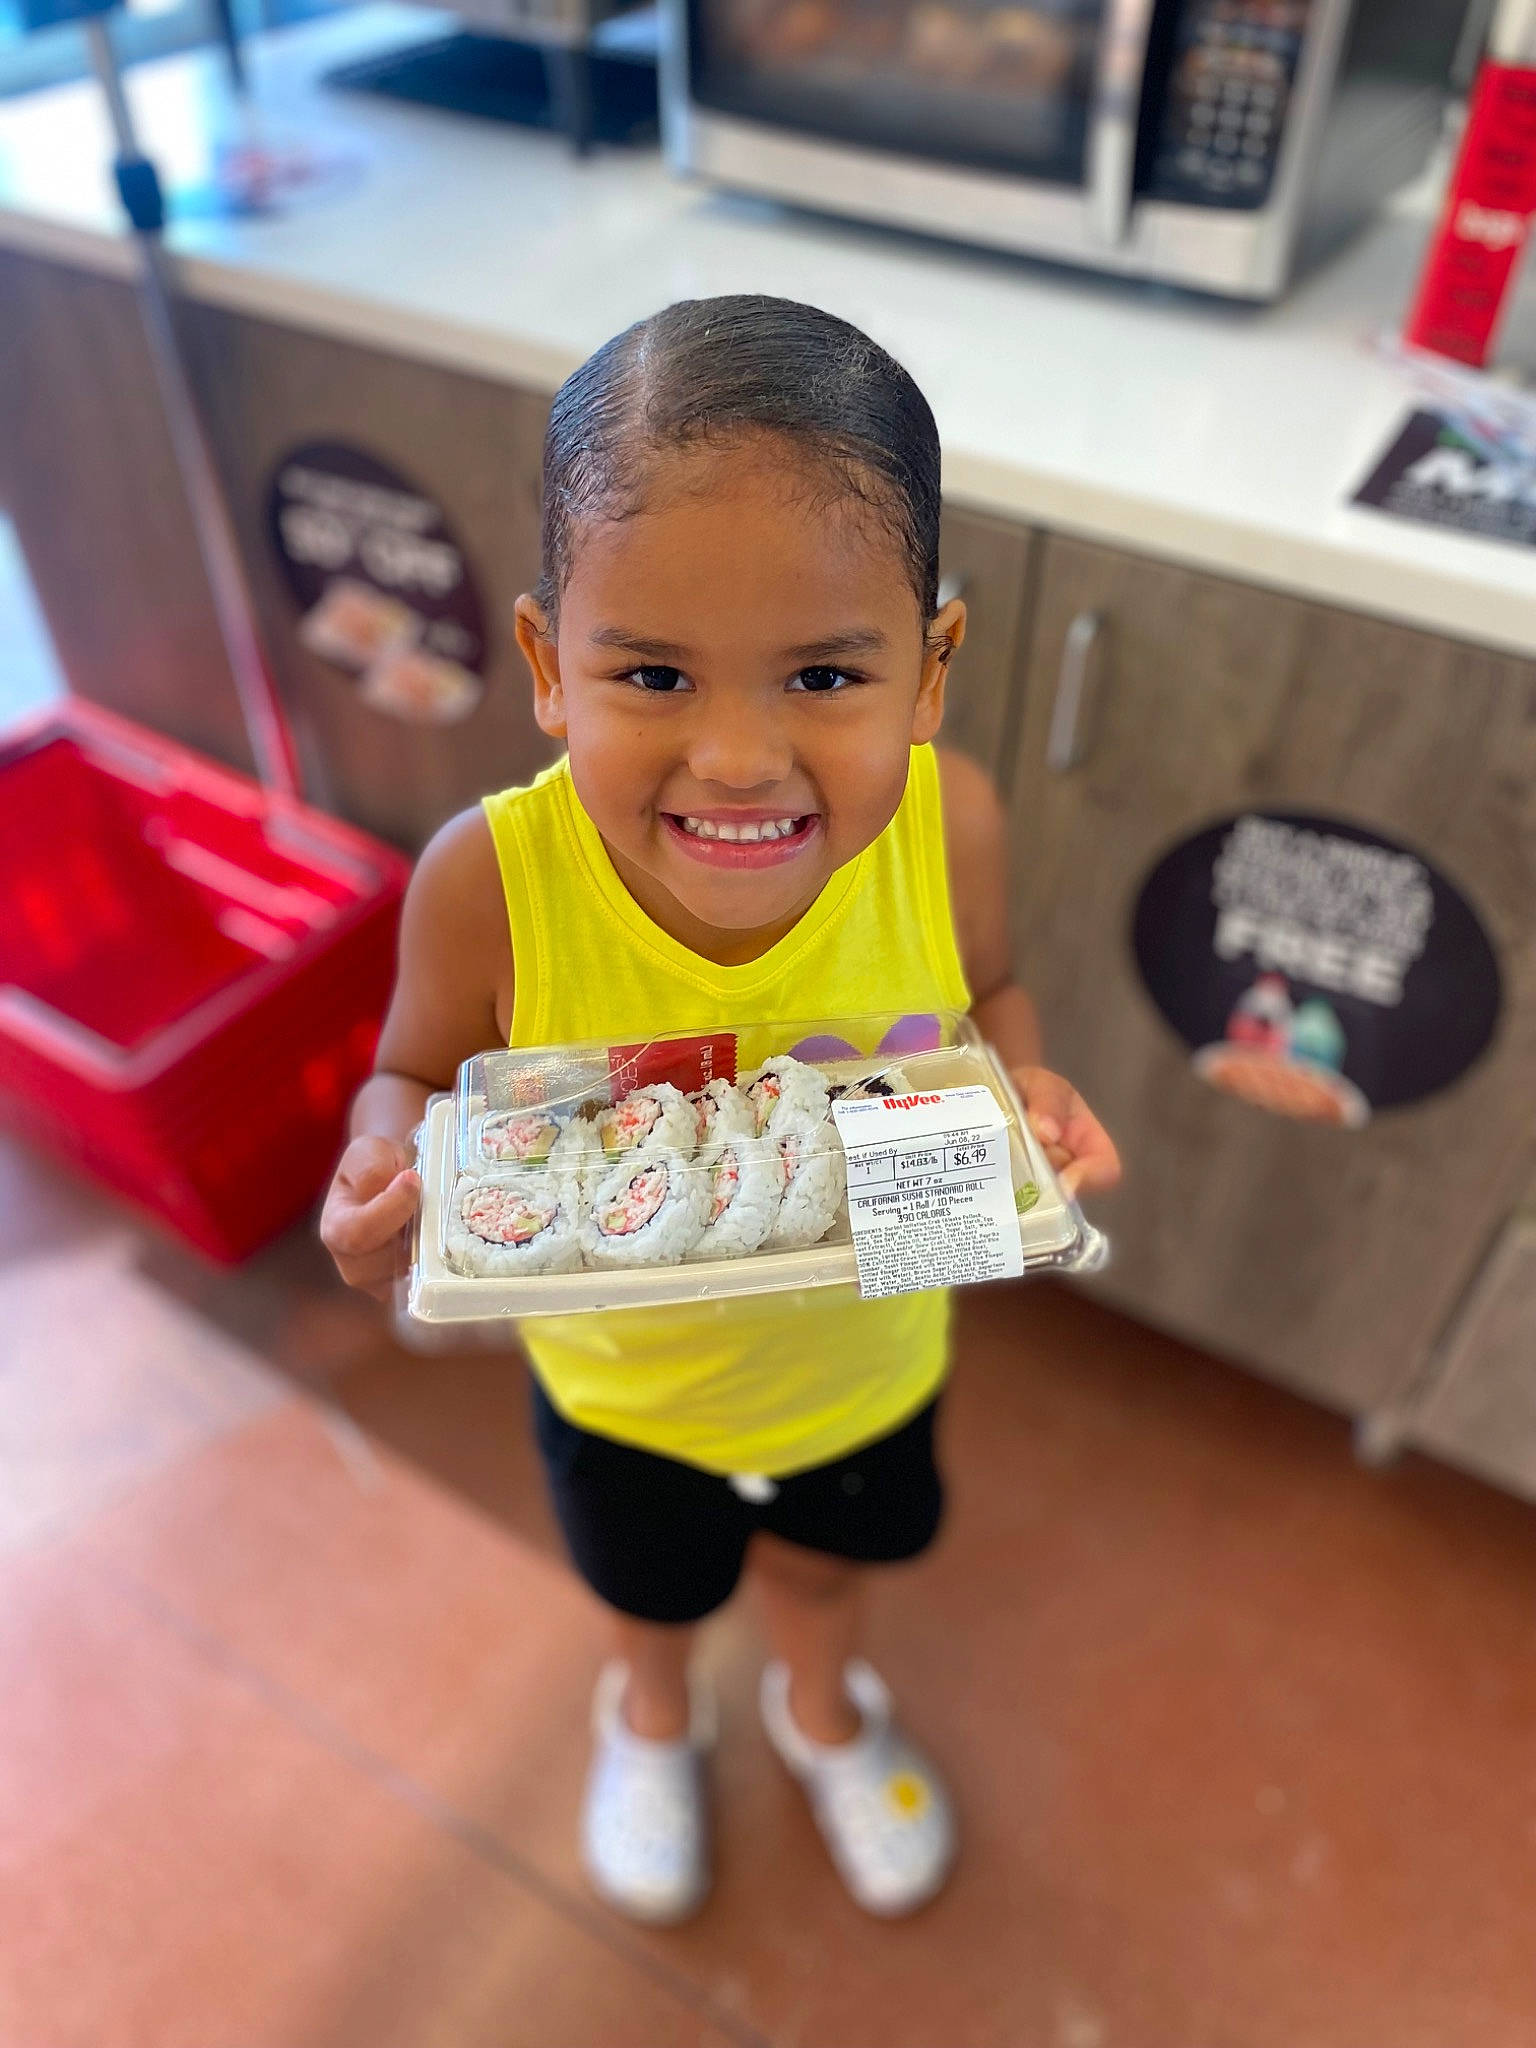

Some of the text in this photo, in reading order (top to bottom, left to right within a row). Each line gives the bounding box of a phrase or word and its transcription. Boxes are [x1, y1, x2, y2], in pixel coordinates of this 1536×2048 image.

[869, 1150, 888, 1158] Used
[888, 1148, 898, 1156] By
[953, 1148, 987, 1166] $6.49
[866, 1166, 871, 1175] 1
[896, 1180, 910, 1190] NET
[912, 1178, 923, 1187] WT
[926, 1177, 932, 1185] 7
[857, 1181, 985, 1208] CALIFORNIA SUSHI STANDARD ROLL
[872, 1207, 902, 1217] Serving
[915, 1199, 930, 1210] Roll
[937, 1196, 948, 1207] 10
[948, 1195, 973, 1205] Pieces
[896, 1207, 952, 1223] 390 CALORIES
